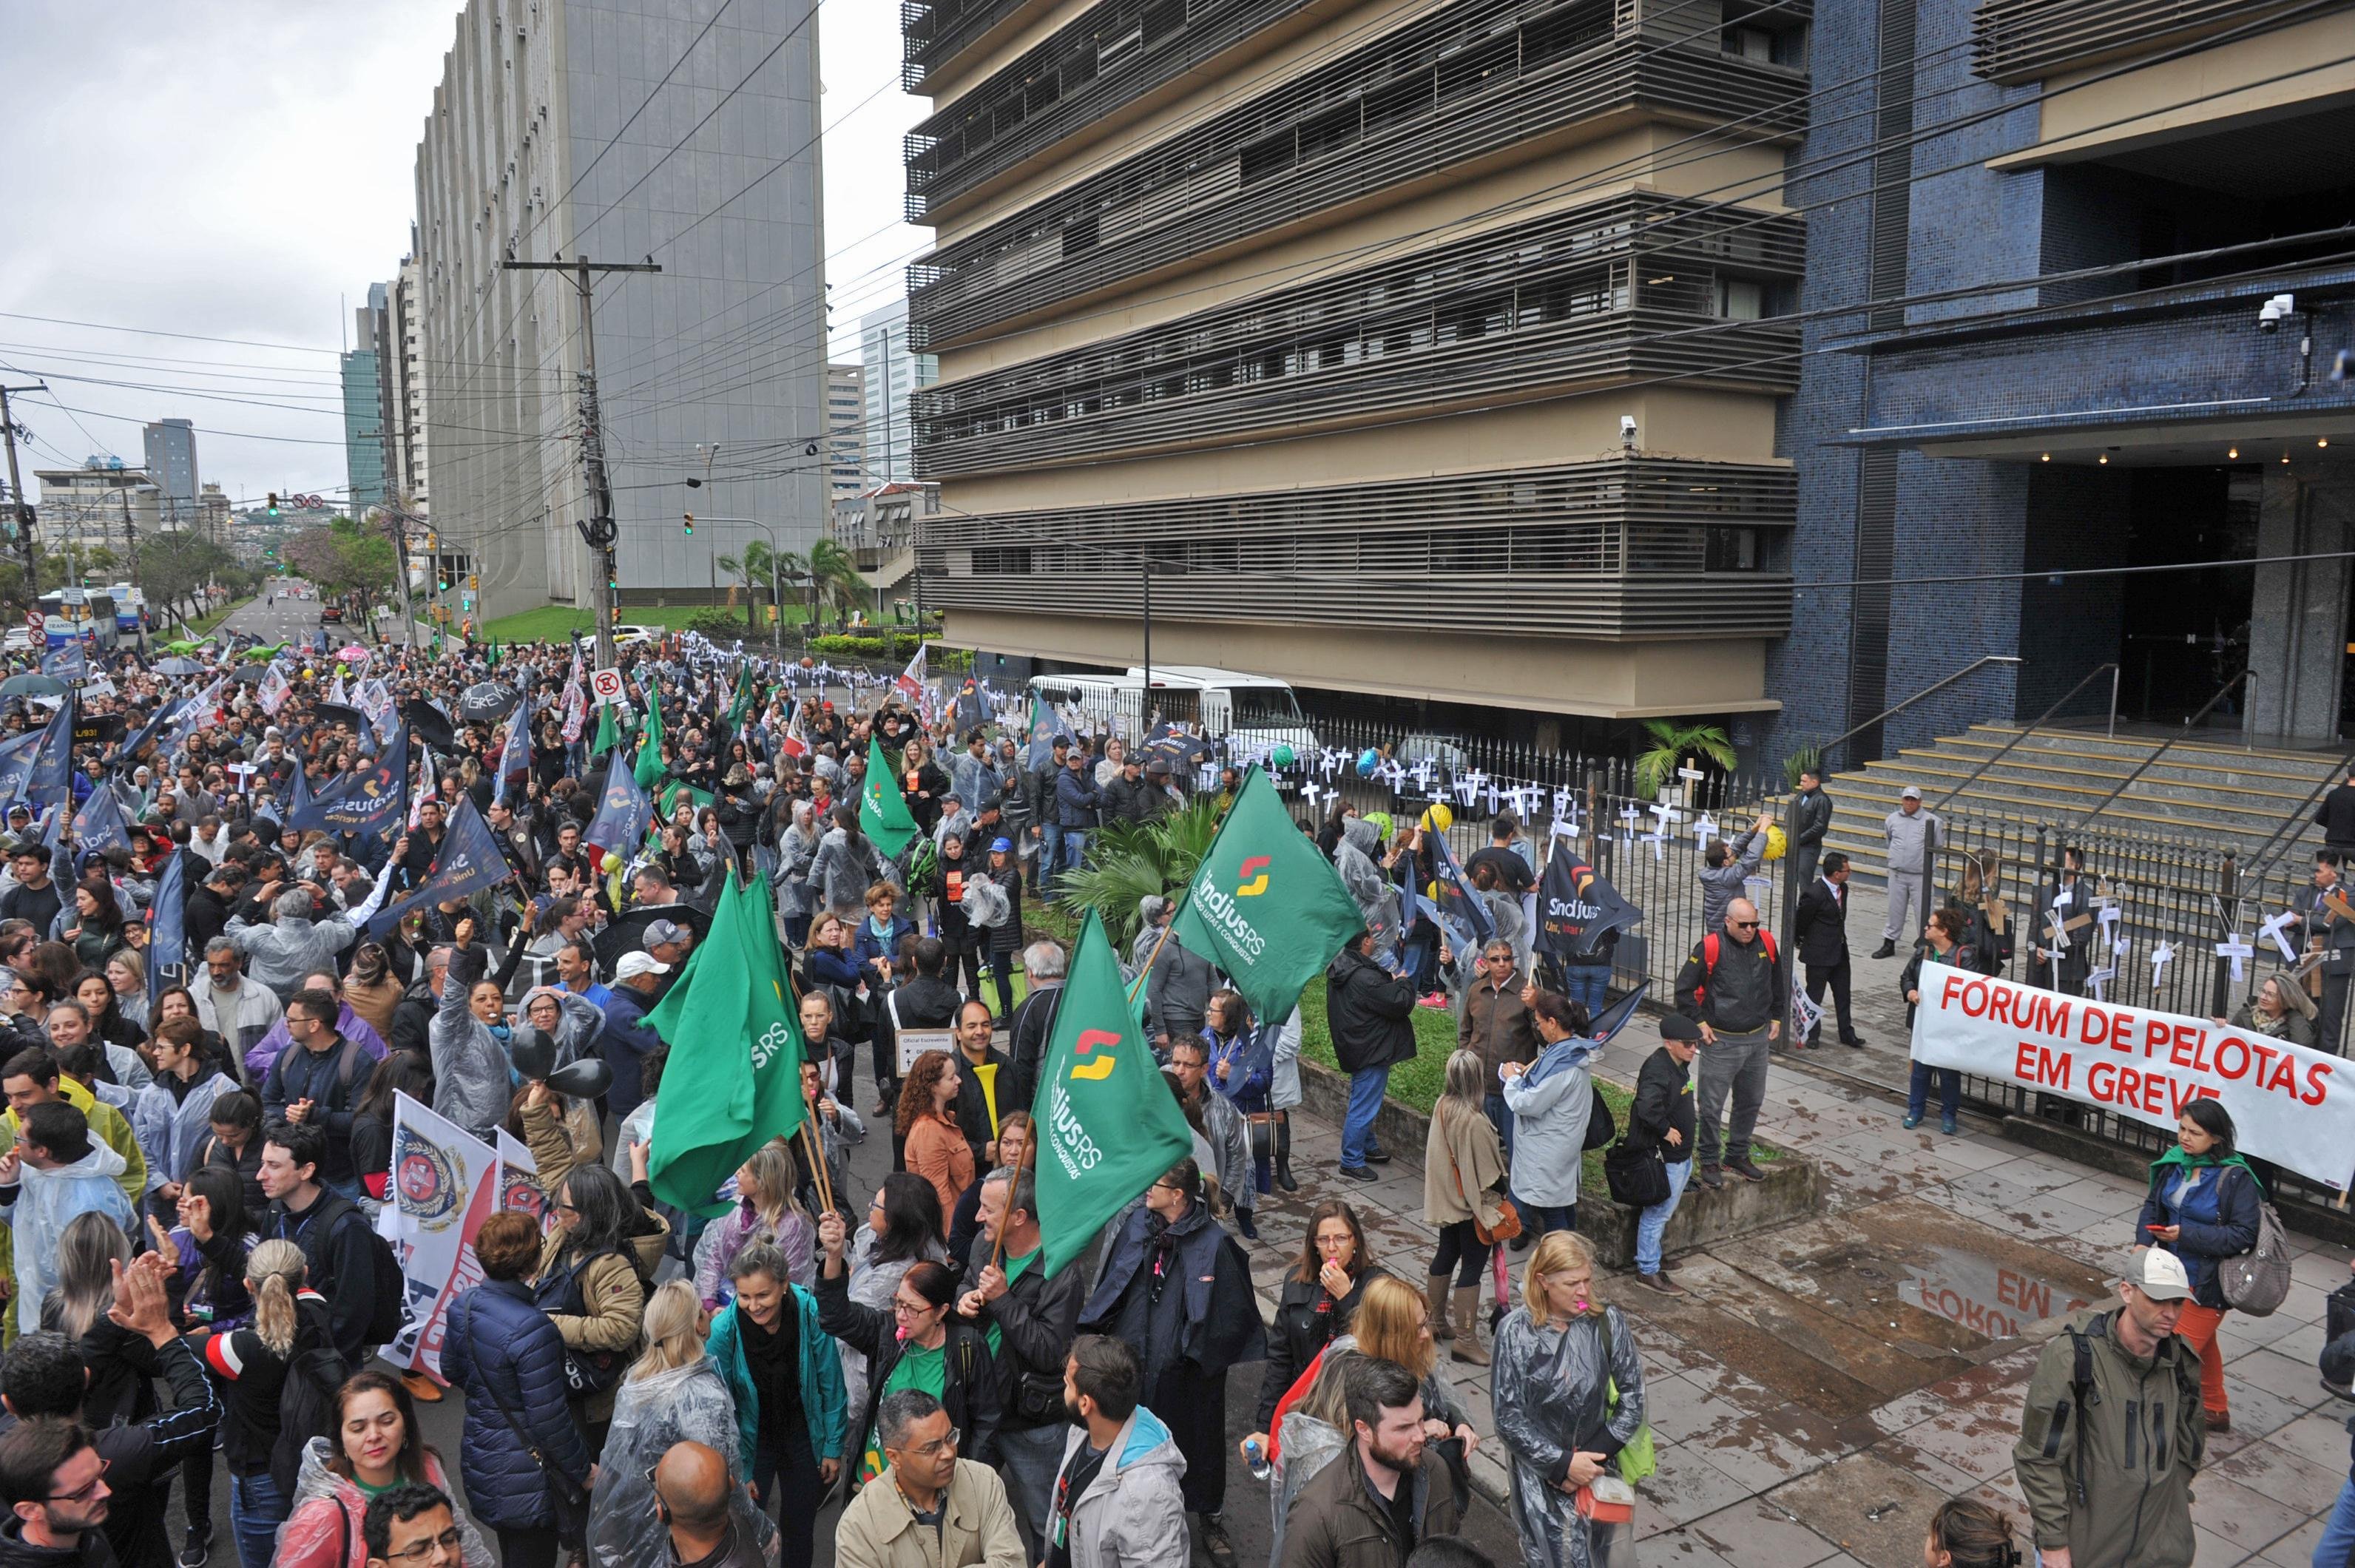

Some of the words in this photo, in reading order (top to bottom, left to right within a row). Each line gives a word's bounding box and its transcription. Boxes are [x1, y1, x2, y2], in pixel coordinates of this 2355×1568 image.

[1220, 929, 1255, 966] CONQUISTAS
[1941, 975, 2072, 1038] FÓRUM
[2080, 1006, 2135, 1053] DE
[2144, 1019, 2333, 1106] PELOTAS
[2015, 1041, 2072, 1091] EM
